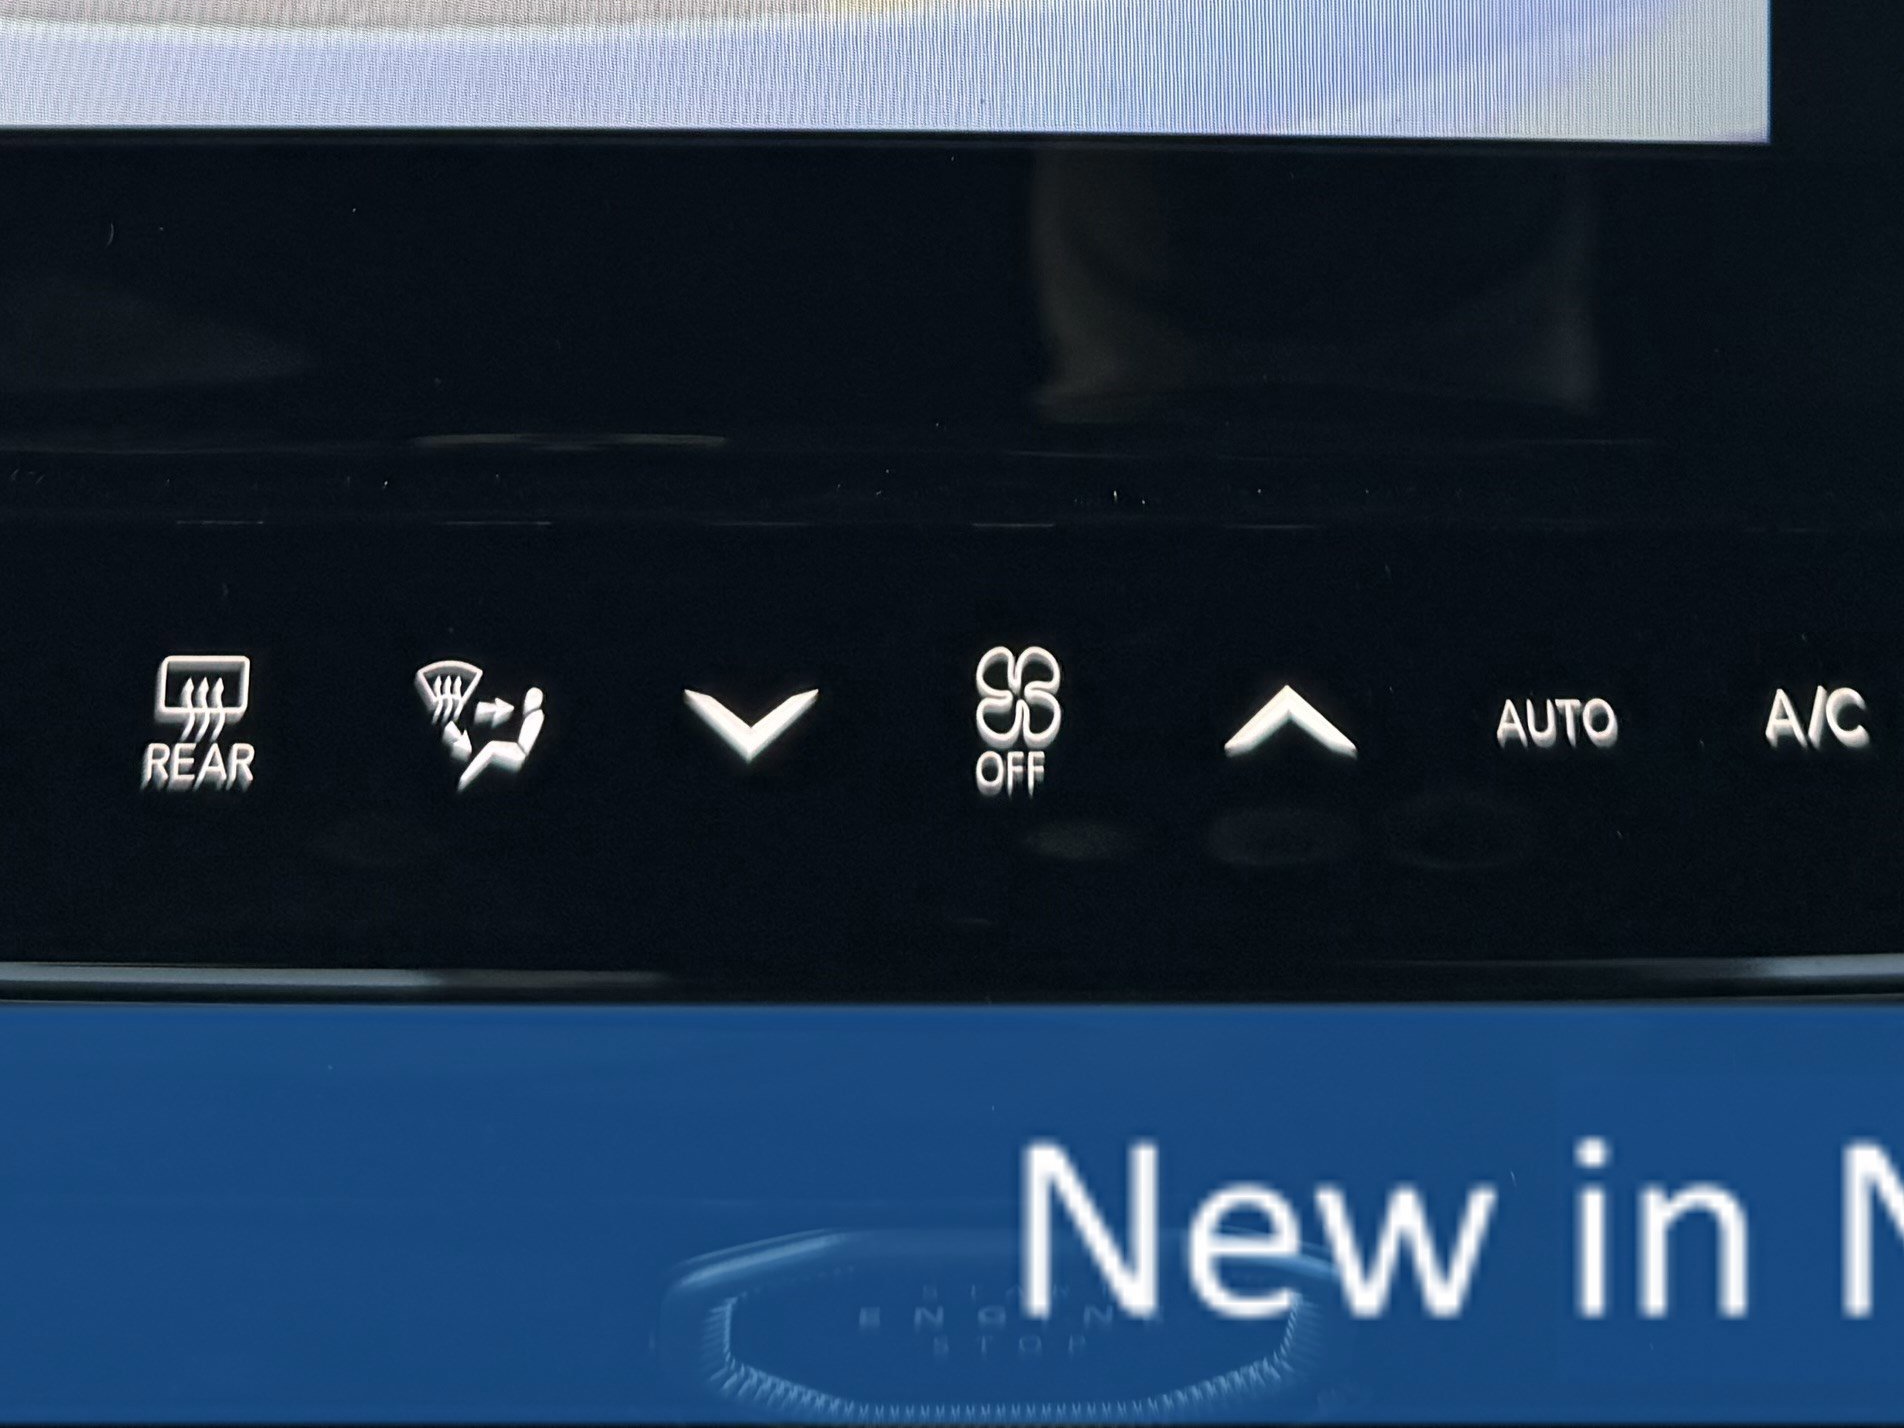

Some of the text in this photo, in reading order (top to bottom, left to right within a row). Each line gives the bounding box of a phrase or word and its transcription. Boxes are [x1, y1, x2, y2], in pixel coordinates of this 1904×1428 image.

[1495, 696, 1620, 749] AUTO
[1764, 684, 1872, 749] A/C
[142, 741, 256, 791] REAR
[974, 749, 1046, 796] OFF
